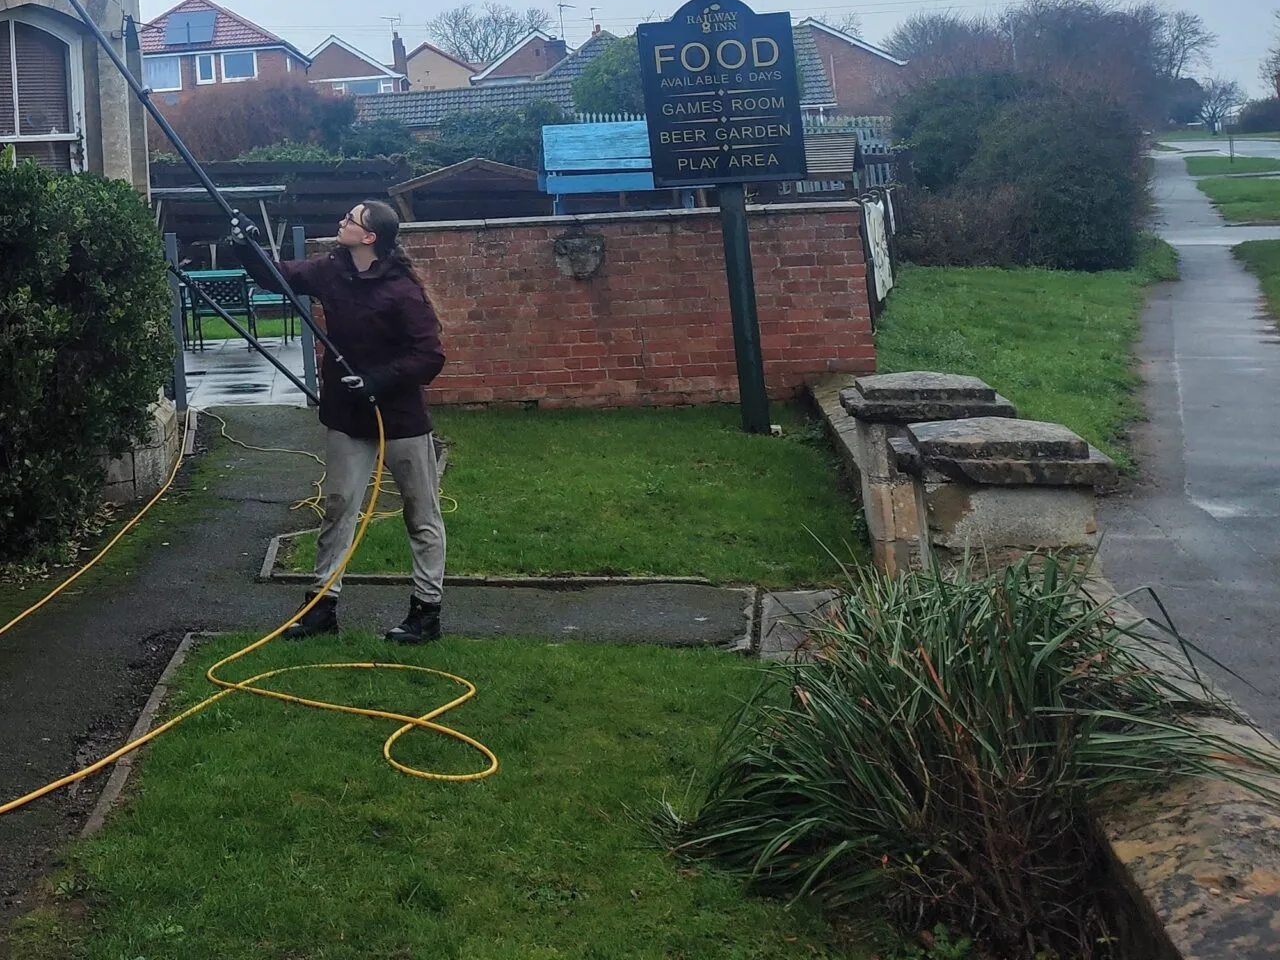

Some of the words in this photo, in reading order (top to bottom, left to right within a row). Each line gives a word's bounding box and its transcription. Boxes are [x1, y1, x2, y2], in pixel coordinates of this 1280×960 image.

[686, 11, 738, 25] RAILWAY
[714, 21, 737, 32] INN
[654, 37, 780, 74] FOOD
[660, 73, 729, 88] AVAILABLE
[735, 73, 743, 83] 6
[749, 70, 783, 82] DAYS
[662, 99, 723, 116] GAMES
[731, 96, 785, 111] ROOM
[660, 129, 707, 144] BEER
[715, 123, 791, 140] GARDEN
[678, 156, 720, 171] PLAY
[728, 153, 779, 168] AREA
